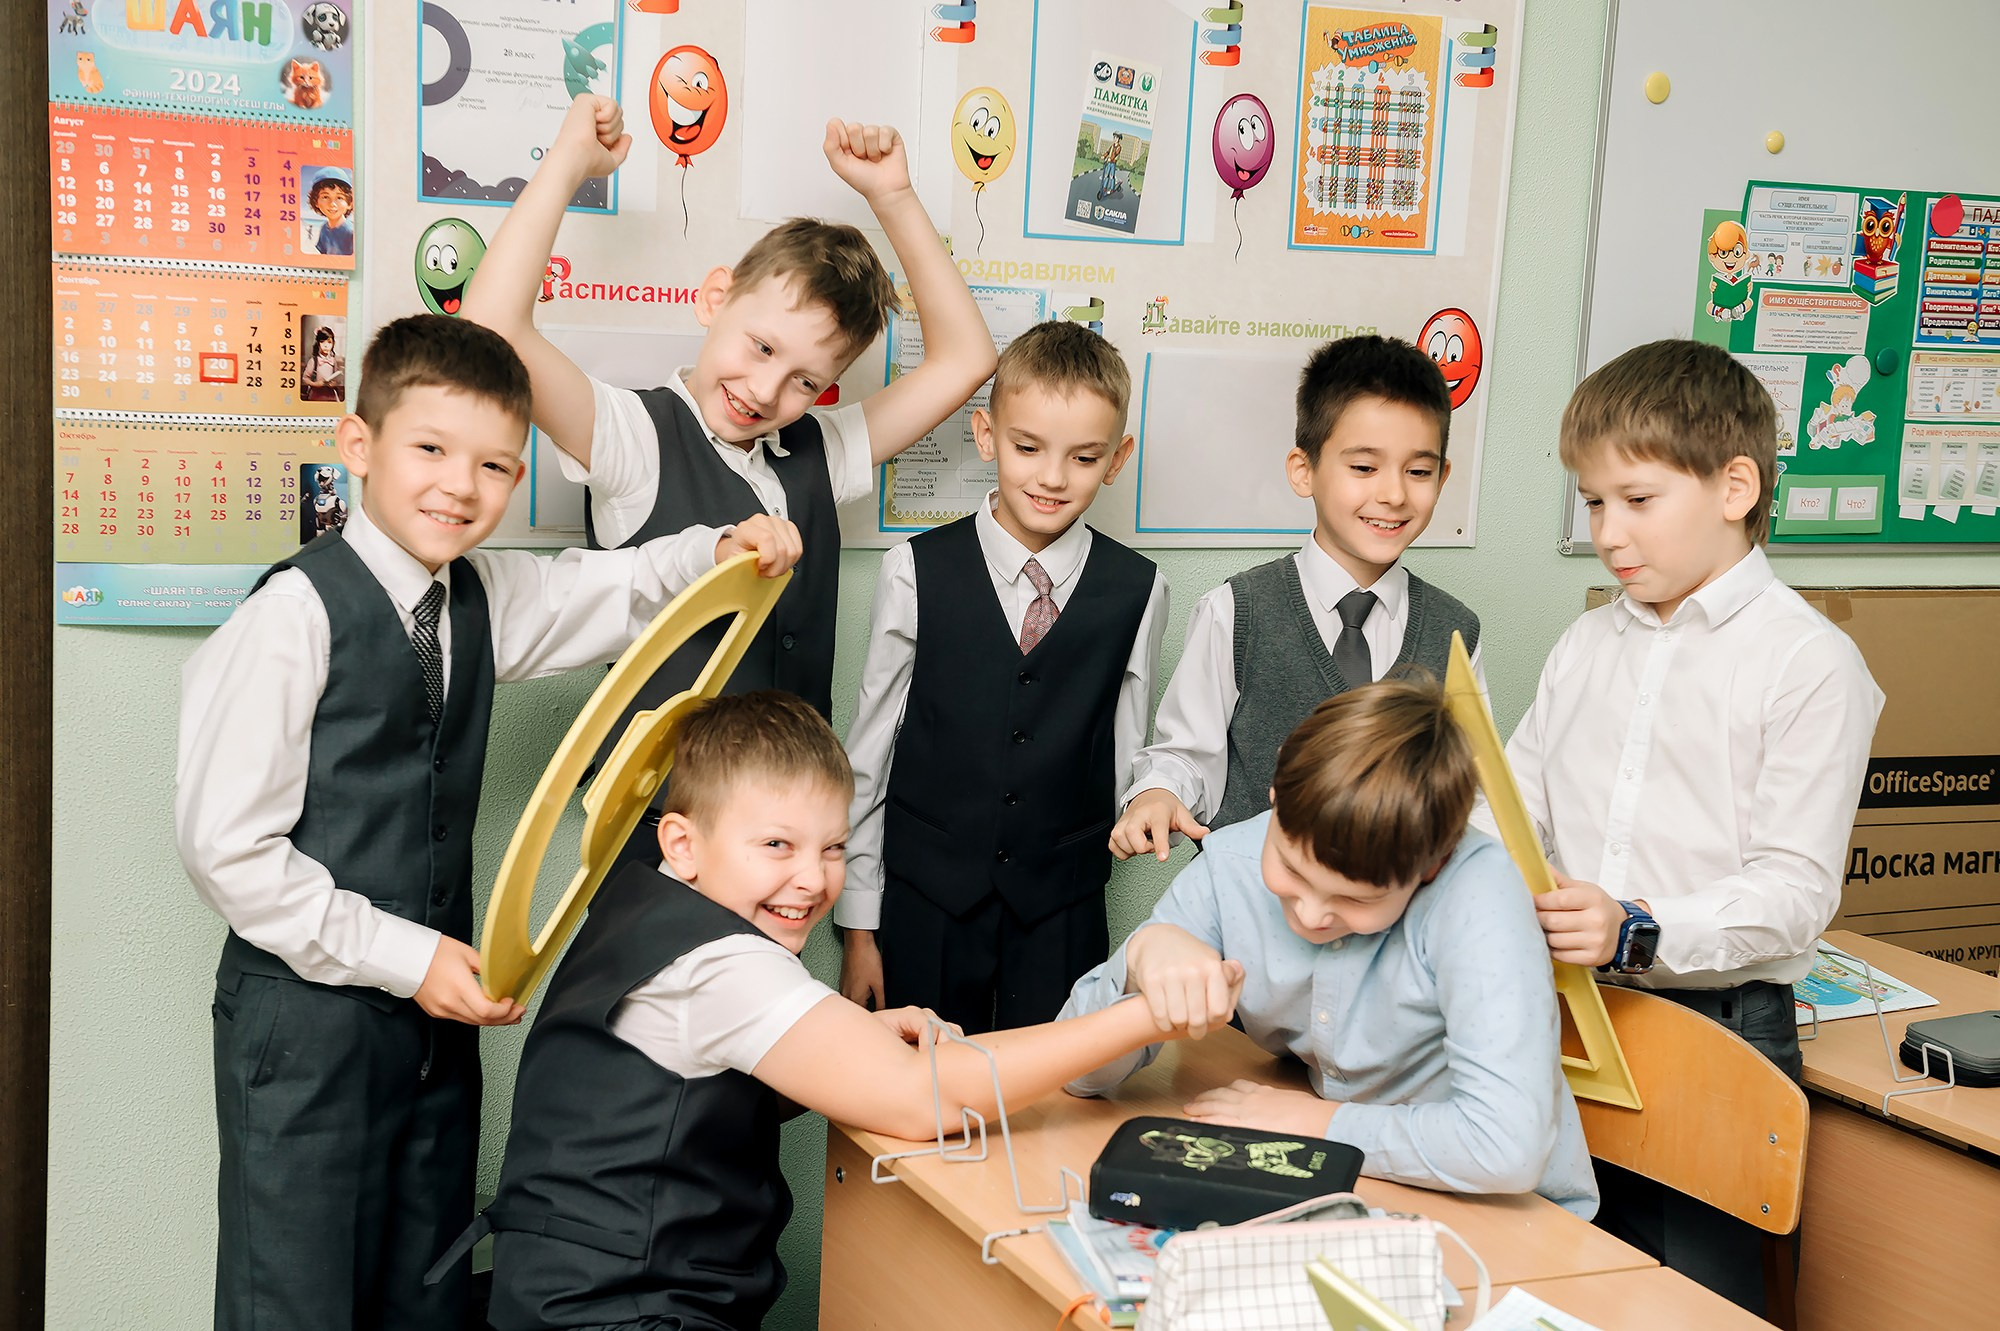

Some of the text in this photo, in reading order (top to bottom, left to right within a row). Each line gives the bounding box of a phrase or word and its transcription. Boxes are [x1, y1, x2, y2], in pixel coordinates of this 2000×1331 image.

[126, 0, 272, 46] ШАЯН
[1342, 24, 1409, 46] ТАБЛИЦА
[1337, 34, 1417, 63] УМНОЖЕНИЯ
[170, 68, 242, 96] 2024
[1338, 70, 1415, 85] 2 3 4 5
[1093, 87, 1148, 111] ПАМЯТКА
[1314, 96, 1321, 106] 2
[264, 102, 285, 111] ЕЛЫ
[54, 116, 84, 127] Август
[1312, 118, 1317, 128] 3
[1310, 147, 1316, 158] 4
[175, 150, 291, 171] 1 2 3 4
[61, 158, 294, 188] 5 6 7 8 9 10 11
[57, 176, 296, 205] 12 13 14 15 16 17 18
[58, 194, 296, 222] 19 20 21 22 23 24 25
[1105, 209, 1127, 220] САКЛА
[57, 211, 260, 236] 26 27 28 29 30 31
[1930, 242, 1982, 252] Именительный
[1929, 257, 1975, 266] Родительный
[953, 254, 1116, 284] оздравляем
[57, 275, 100, 285] Сентябрь
[1927, 272, 1966, 281] Дательный
[1925, 288, 1972, 297] Винительный
[1788, 297, 1862, 308] СУЩЕСТВИТЕЛЬНОЕ
[1925, 303, 1974, 312] Творительный
[285, 311, 291, 322] 1
[1142, 296, 1378, 339] Давайте знакомиться
[1923, 318, 1968, 327] Предложный
[64, 316, 292, 339] 2 3 4 5 6 7 8
[65, 334, 295, 355] 9 10 11 12 13 14 15
[61, 351, 295, 372] 16 17 18 19 20 21 22
[61, 368, 295, 388] 23 24 25 26 28 29
[61, 385, 80, 397] 30
[60, 432, 97, 440] Октябрь
[1912, 428, 1925, 436] Род
[104, 457, 291, 472] 1 2 3 4 5 6
[66, 472, 295, 488] 7 8 9 10 11 12 13
[62, 490, 295, 504] 14 15 16 17 18 19 20
[1800, 498, 1866, 509] Кто? Что?
[62, 506, 295, 521] 21 22 23 24 25 26 27
[62, 523, 190, 537] 28 29 30 31
[62, 589, 104, 603] ШАЯН
[144, 586, 246, 595] «ШАЯН ТВ» белән
[117, 599, 232, 610] телне саклау менә
[1869, 770, 1991, 796] OfficeSpace
[1846, 848, 1935, 885] Доска
[1917, 948, 1964, 962] ЖНО
